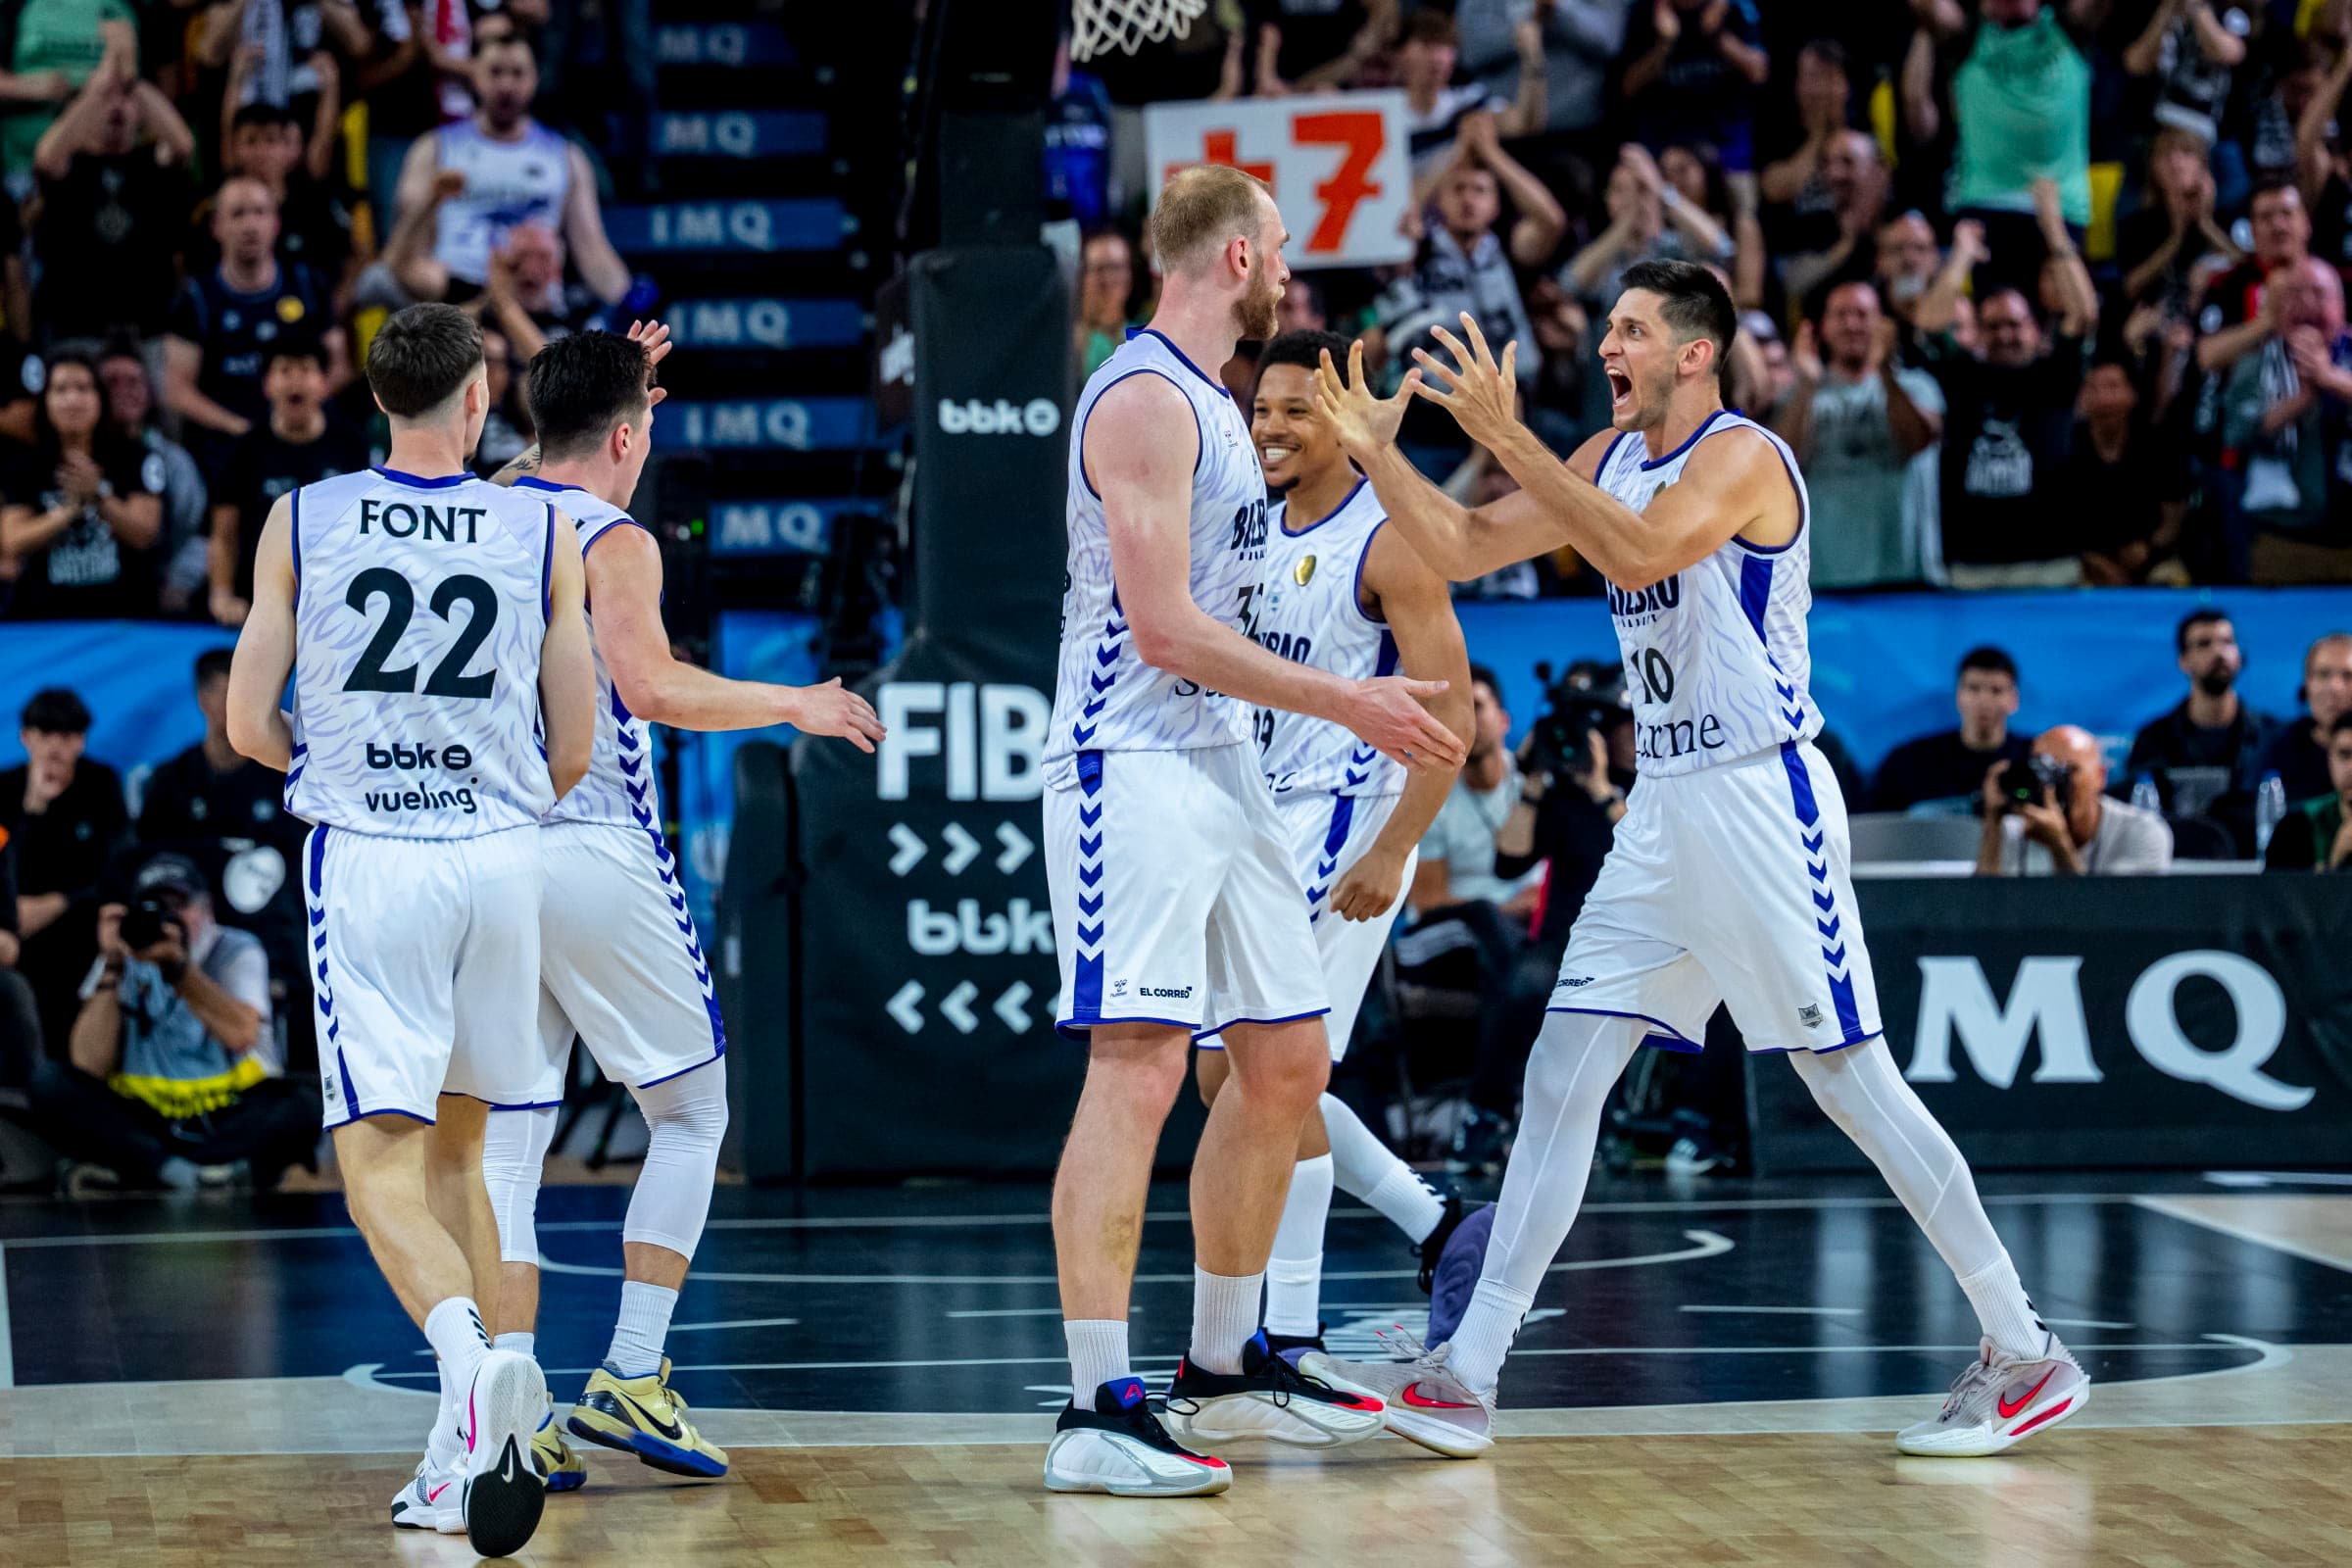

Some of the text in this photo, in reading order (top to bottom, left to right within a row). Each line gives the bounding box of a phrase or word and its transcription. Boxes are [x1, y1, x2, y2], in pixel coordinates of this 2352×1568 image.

[658, 23, 745, 67] MQ
[662, 112, 755, 158] MQ
[651, 200, 772, 252] IMQ
[668, 299, 791, 349] IMQ
[684, 401, 810, 451] IMQ
[938, 397, 1025, 434] bbk
[360, 499, 487, 543] FONT
[721, 503, 828, 553] MQ
[342, 566, 498, 699] 22
[1631, 648, 1674, 704] 10
[366, 743, 436, 769] bbk
[877, 682, 1053, 801] FIB
[366, 782, 477, 814] vueling
[1140, 987, 1153, 997] EL
[1153, 988, 1190, 999] CORREO
[1903, 949, 2317, 1112] MQ
